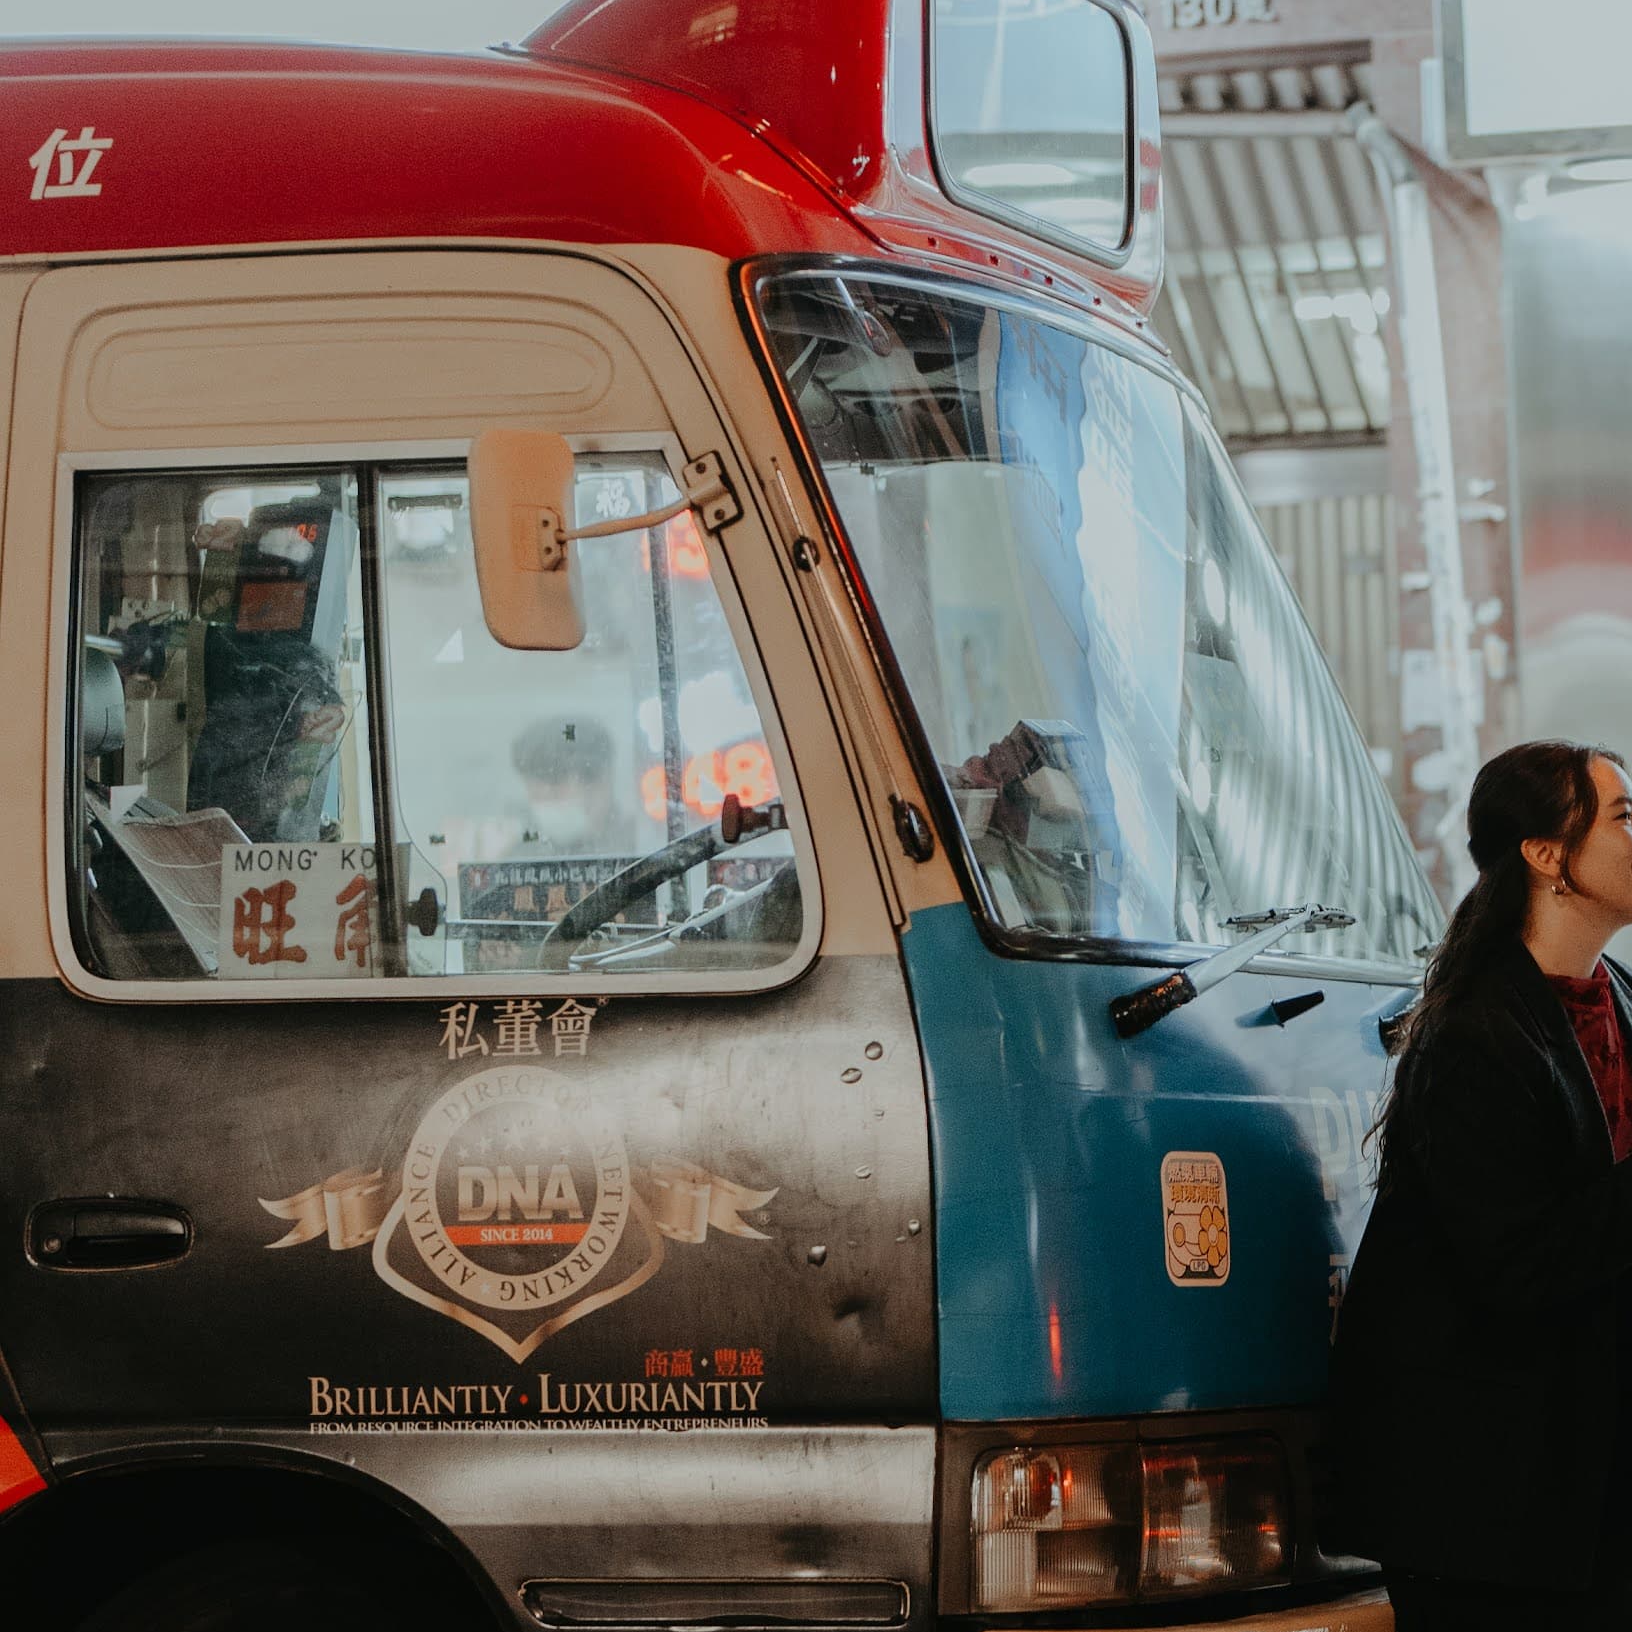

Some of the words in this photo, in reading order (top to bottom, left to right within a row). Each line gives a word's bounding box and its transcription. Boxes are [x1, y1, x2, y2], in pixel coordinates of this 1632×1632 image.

[28, 126, 114, 200] 位
[234, 849, 314, 872] MONG
[340, 847, 377, 871] KO
[438, 998, 599, 1060] 私董會
[408, 1142, 478, 1288] ALLIANCE
[457, 1164, 585, 1223] DNA
[480, 1228, 520, 1243] SINCE
[522, 1227, 554, 1243] 2014
[499, 1140, 625, 1303] NETWORKING
[1193, 1261, 1206, 1271] LPG
[307, 1376, 514, 1416] BRILLIANTLY
[537, 1372, 765, 1414] LUXURIANTLY
[310, 1422, 353, 1435] FROM
[359, 1420, 434, 1434] RESOURCE
[437, 1419, 543, 1434] INTEGRATION
[543, 1419, 568, 1432] TO
